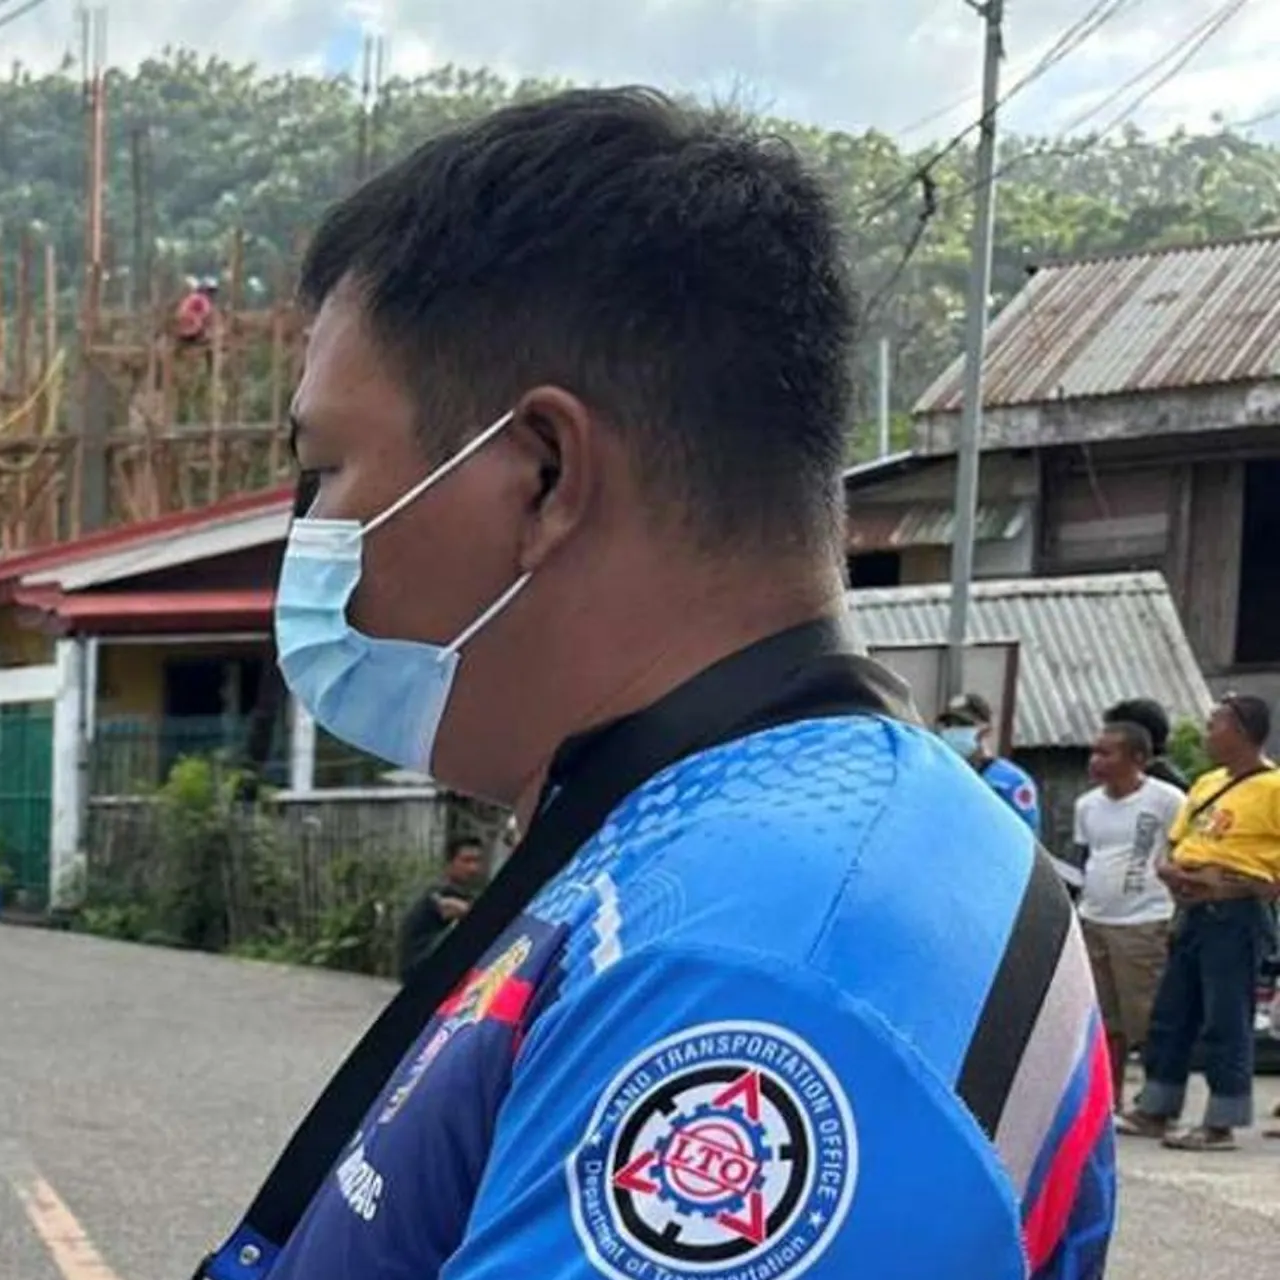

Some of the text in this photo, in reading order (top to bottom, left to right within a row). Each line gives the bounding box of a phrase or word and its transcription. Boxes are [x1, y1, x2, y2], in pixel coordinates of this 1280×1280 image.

[605, 1034, 843, 1201] LAND TRANSPORTATION OFFICE
[672, 1138, 748, 1189] LTO
[582, 1160, 626, 1262] Department
[626, 1258, 648, 1276] of
